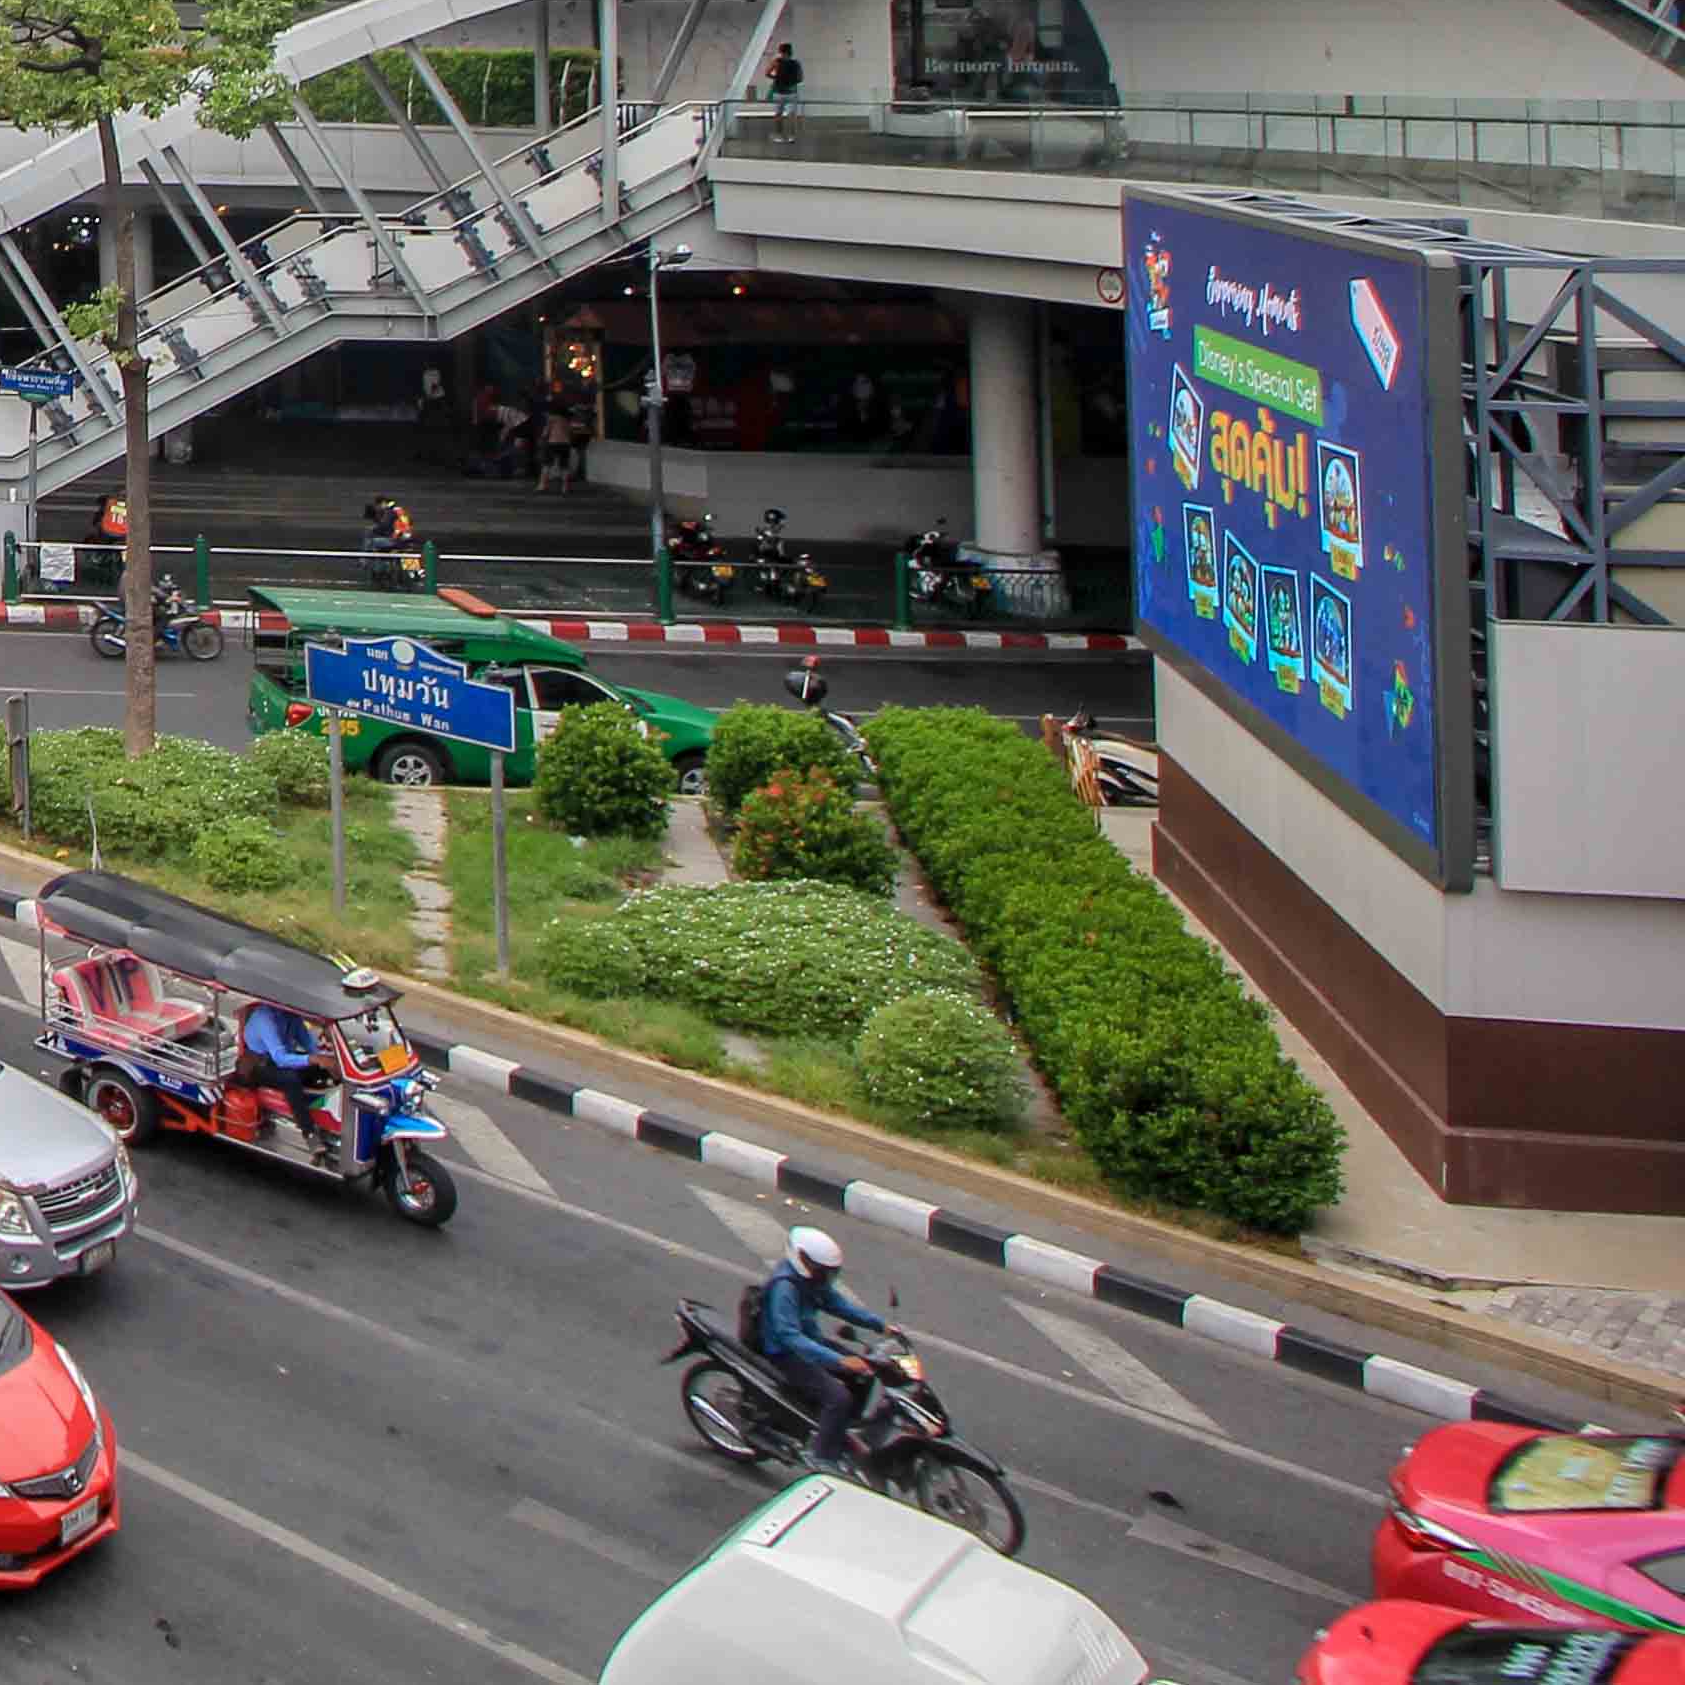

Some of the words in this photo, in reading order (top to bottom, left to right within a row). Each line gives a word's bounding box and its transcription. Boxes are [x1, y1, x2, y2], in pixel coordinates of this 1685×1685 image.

[924, 58, 949, 74] Be
[1199, 339, 1246, 384] Disney's
[1246, 360, 1294, 404] Special
[1296, 377, 1318, 413] Set
[361, 666, 451, 711] ปทุมวัน
[420, 712, 451, 731] Wan
[77, 956, 140, 1012] VIP
